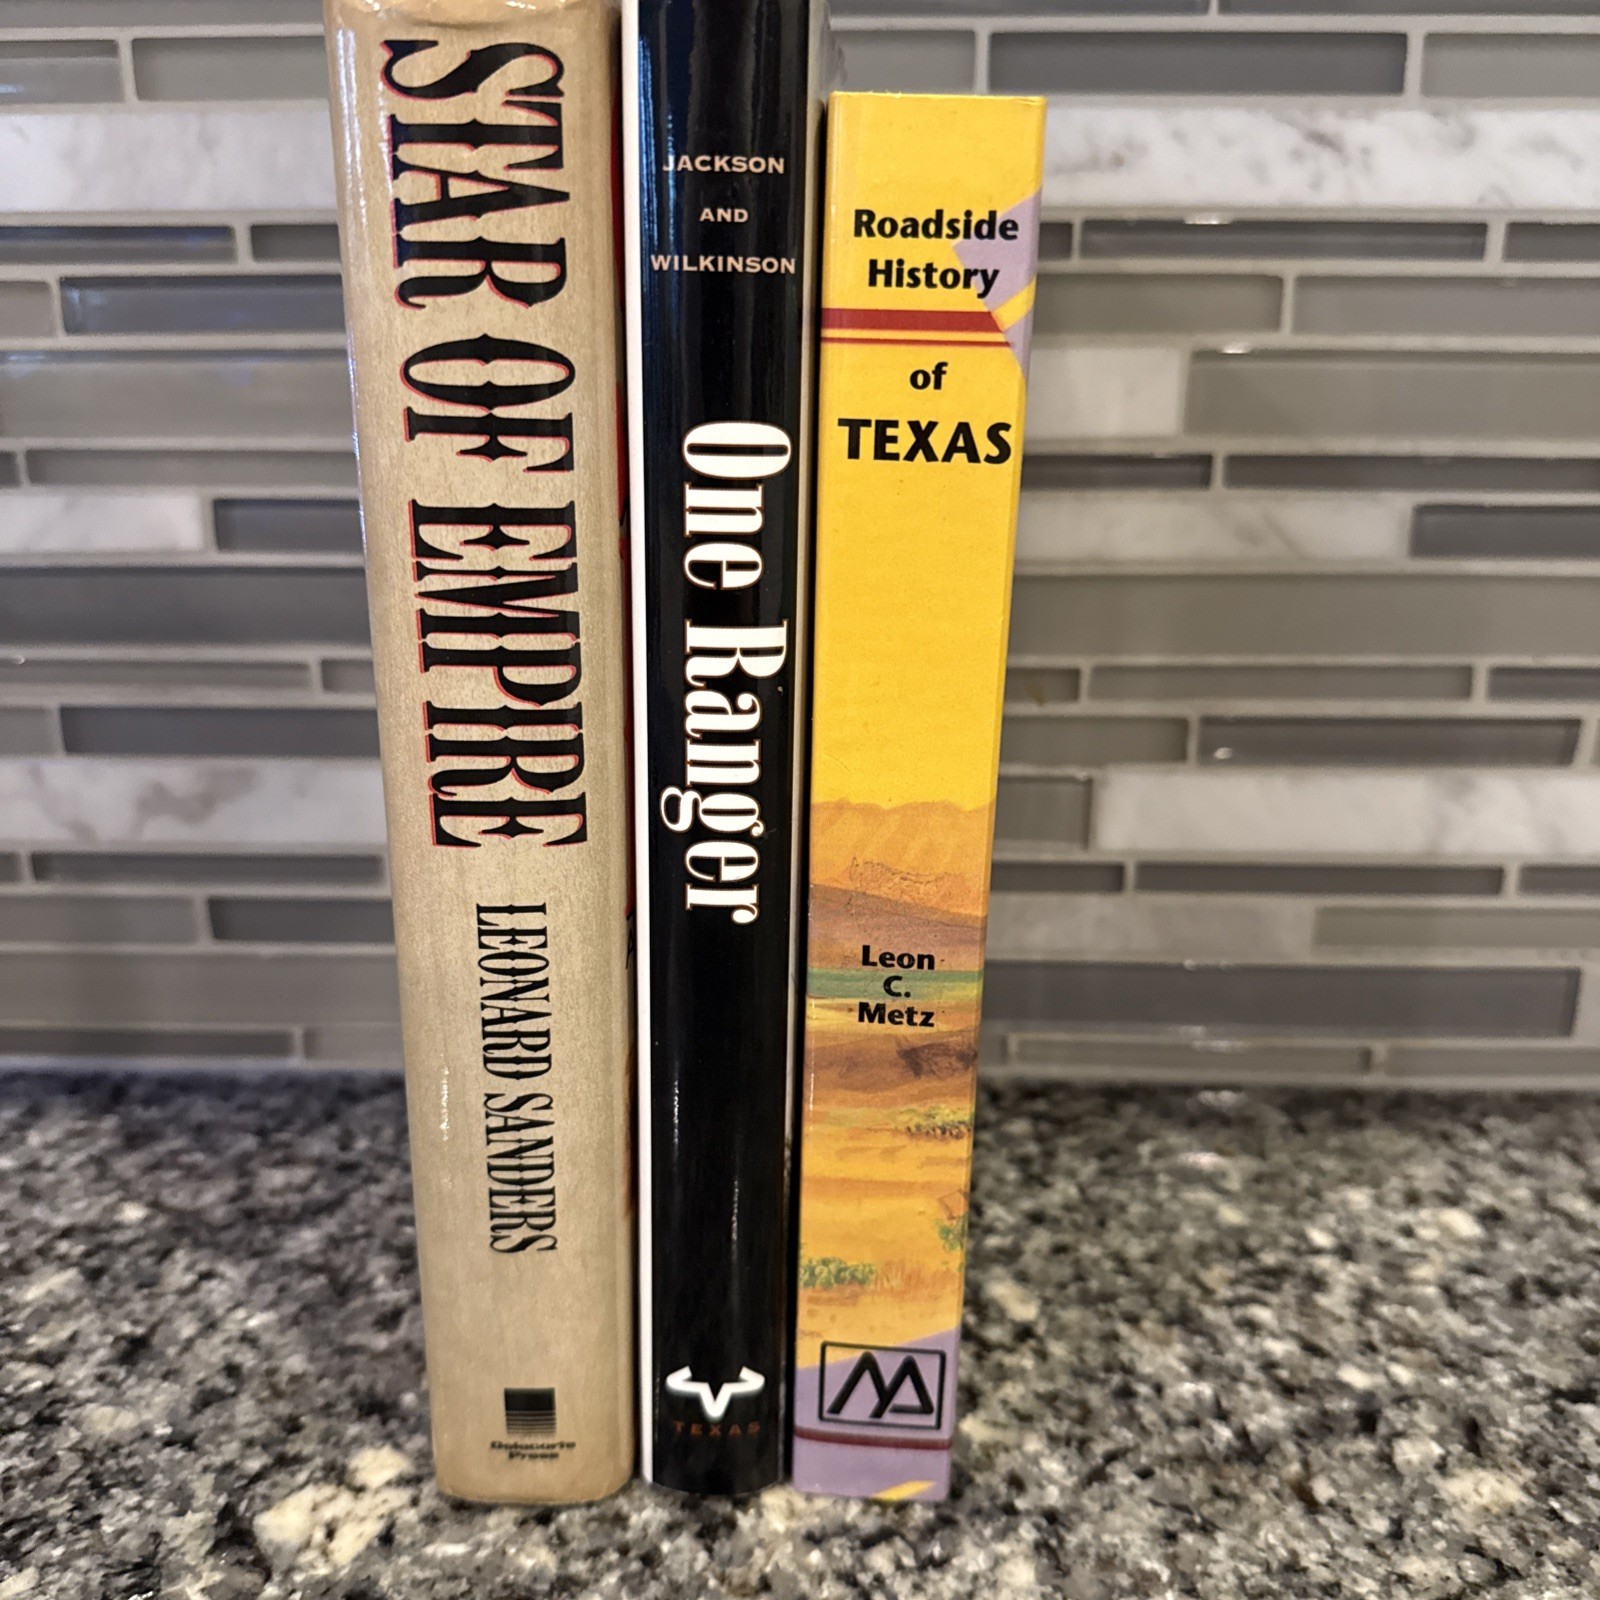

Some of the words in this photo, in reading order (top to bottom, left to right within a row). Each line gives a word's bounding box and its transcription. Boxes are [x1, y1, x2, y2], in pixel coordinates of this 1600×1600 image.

[380, 39, 571, 310] STAR
[662, 155, 785, 175] JACKSON
[699, 207, 749, 224] AND
[853, 208, 1019, 241] Roadside
[650, 254, 796, 275] WILKINSON
[867, 258, 1000, 299] History
[909, 361, 949, 391] of
[400, 333, 576, 473] OF
[837, 417, 1013, 465] TEXAS
[682, 421, 792, 590] One
[408, 499, 588, 848] EMPIRE
[660, 619, 790, 926] Ranger
[861, 944, 936, 971] Leon
[476, 902, 552, 1079] LEONARD
[882, 975, 912, 998] C.
[857, 1001, 935, 1028] Metz
[483, 1092, 558, 1254] SANDERS
[673, 1421, 761, 1438] TEXAS
